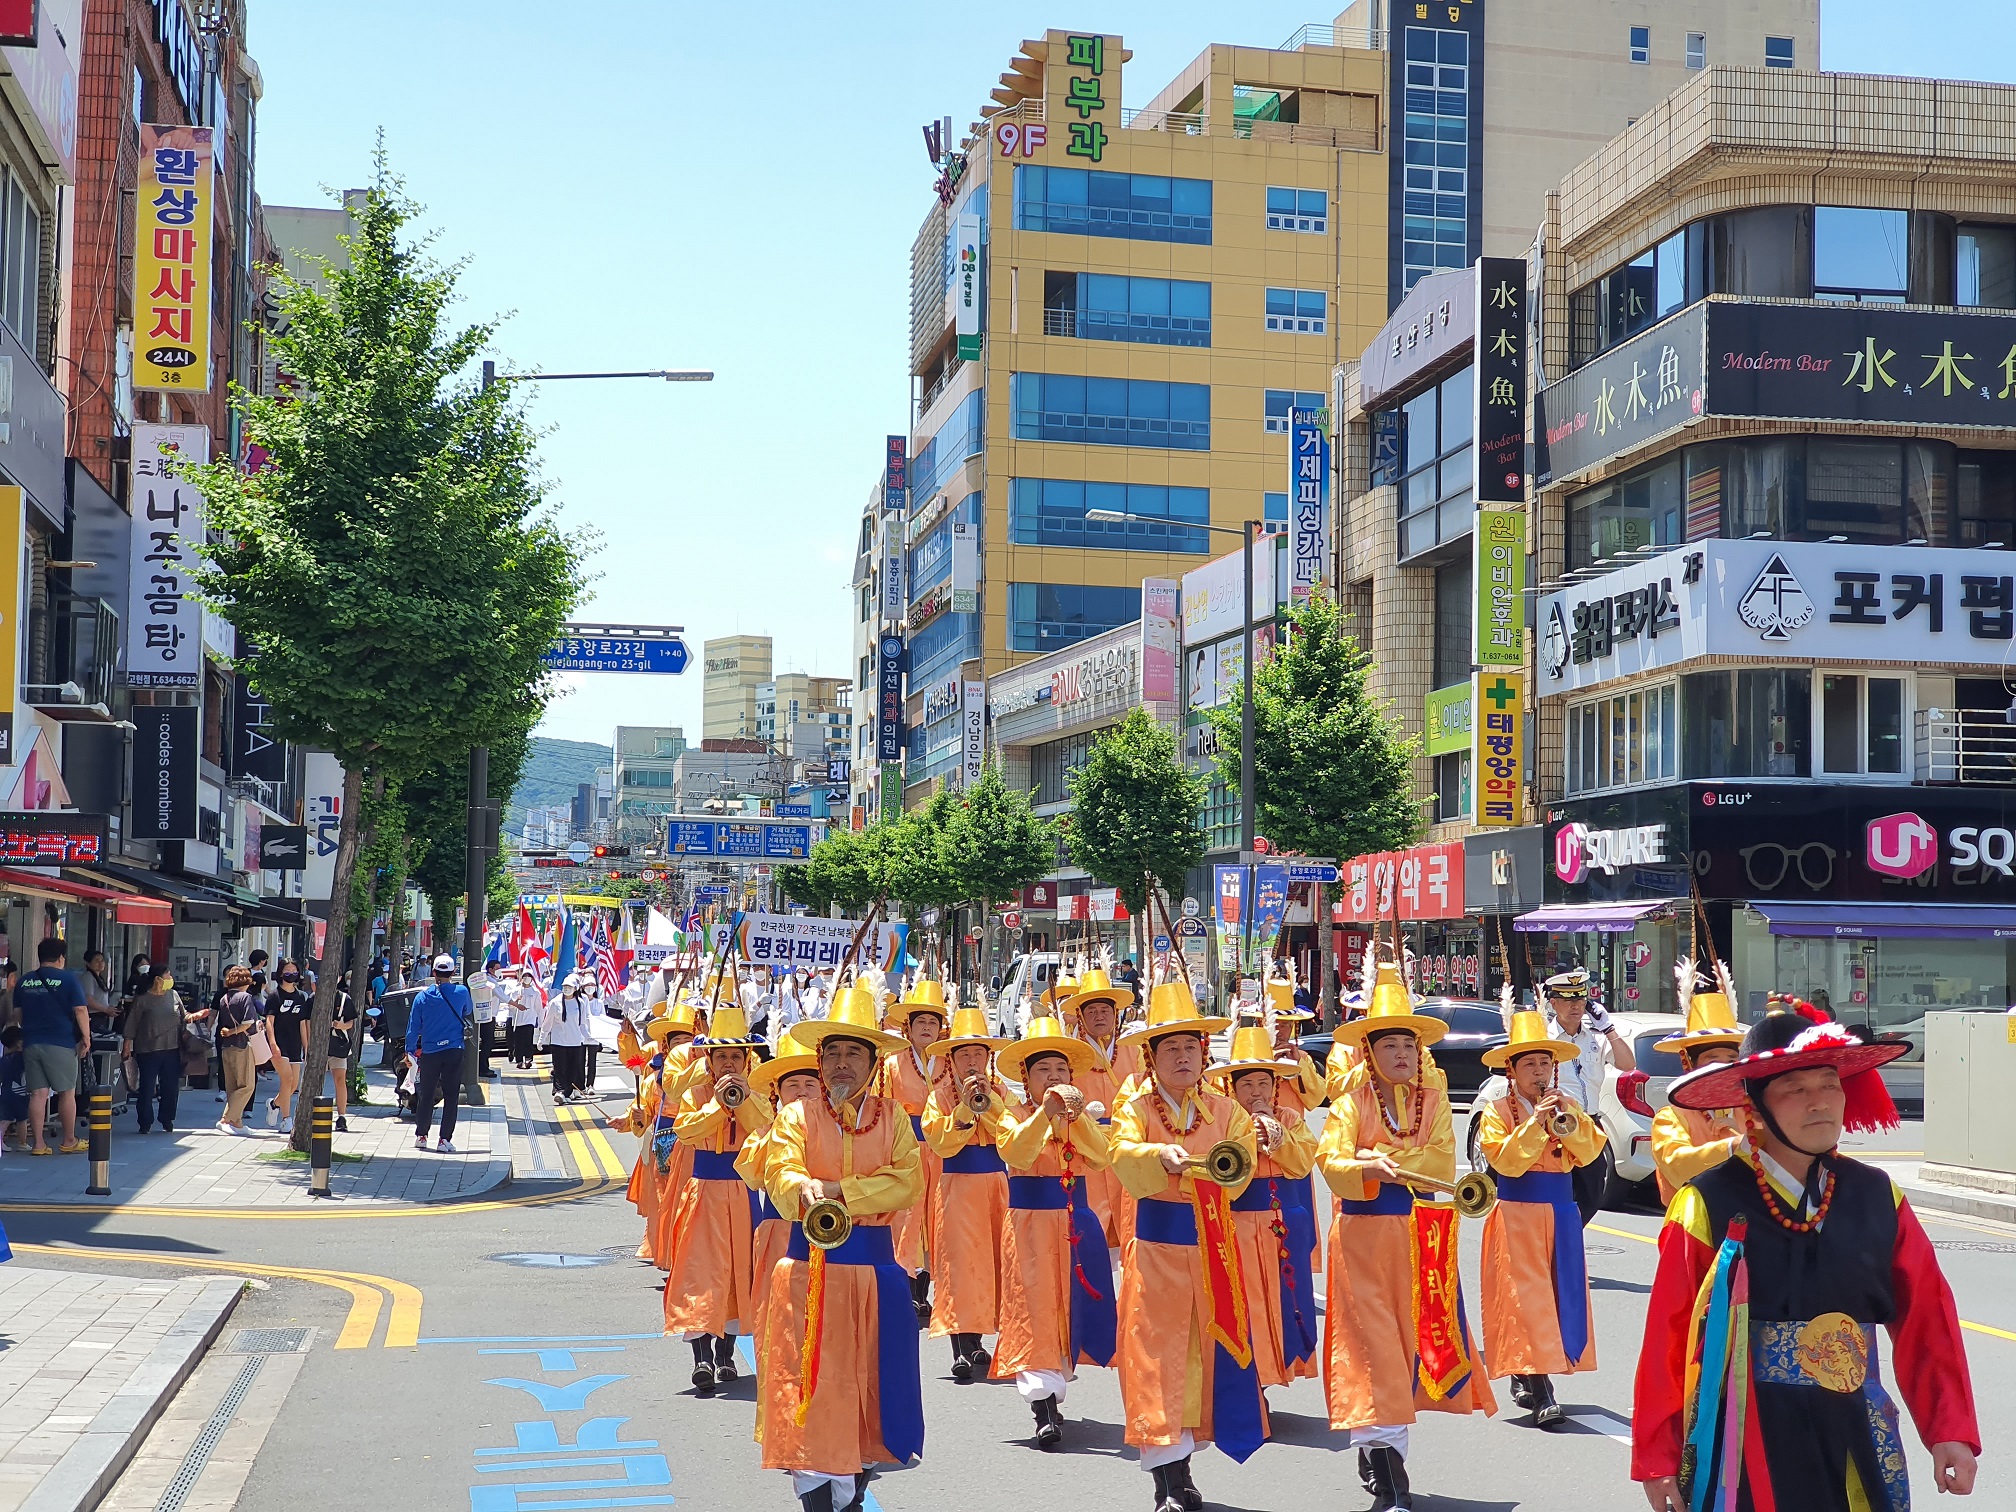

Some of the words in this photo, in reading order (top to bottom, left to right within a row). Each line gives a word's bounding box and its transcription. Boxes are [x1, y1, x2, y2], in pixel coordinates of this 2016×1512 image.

[1065, 35, 1108, 162] 피부과
[996, 122, 1047, 158] 9F
[961, 263, 976, 273] DB
[152, 350, 192, 366] 24시
[1722, 350, 1793, 373] Modern
[1796, 353, 1832, 373] Bar
[160, 371, 182, 384] 3층
[1482, 432, 1521, 455] Modern
[1546, 418, 1573, 448] Modern
[1573, 411, 1589, 432] Bar
[888, 438, 905, 489] 피부과
[1497, 449, 1517, 465] Bar
[1506, 475, 1519, 485] 3F
[889, 498, 903, 507] 9F
[1297, 428, 1323, 584] 거제피싱카페
[144, 488, 188, 662] 나주곰탕
[1682, 552, 1704, 584] 2F
[1570, 577, 1680, 665] 홀덤포커스
[551, 640, 645, 659] 제중앙로23길
[621, 659, 651, 671] 23-gil
[1482, 652, 1520, 661] T.637-0614
[128, 674, 151, 685] 고현점
[152, 675, 197, 685] T.634-6622
[1051, 665, 1084, 706] BNK
[1082, 645, 1131, 699] 경남은행
[883, 660, 898, 756] 오션치과의원
[158, 722, 173, 767] codes
[967, 711, 982, 777] 경남은행
[1485, 713, 1517, 821] 태평양약국
[158, 768, 173, 832] combine
[777, 805, 810, 815] 고현사거리
[317, 796, 341, 857] FILA
[1586, 823, 1667, 875] SQUARE
[1949, 826, 2016, 876] SQ
[1332, 855, 1449, 914] 평양약국
[760, 920, 795, 933] 한국전쟁
[797, 924, 827, 936] 72주년
